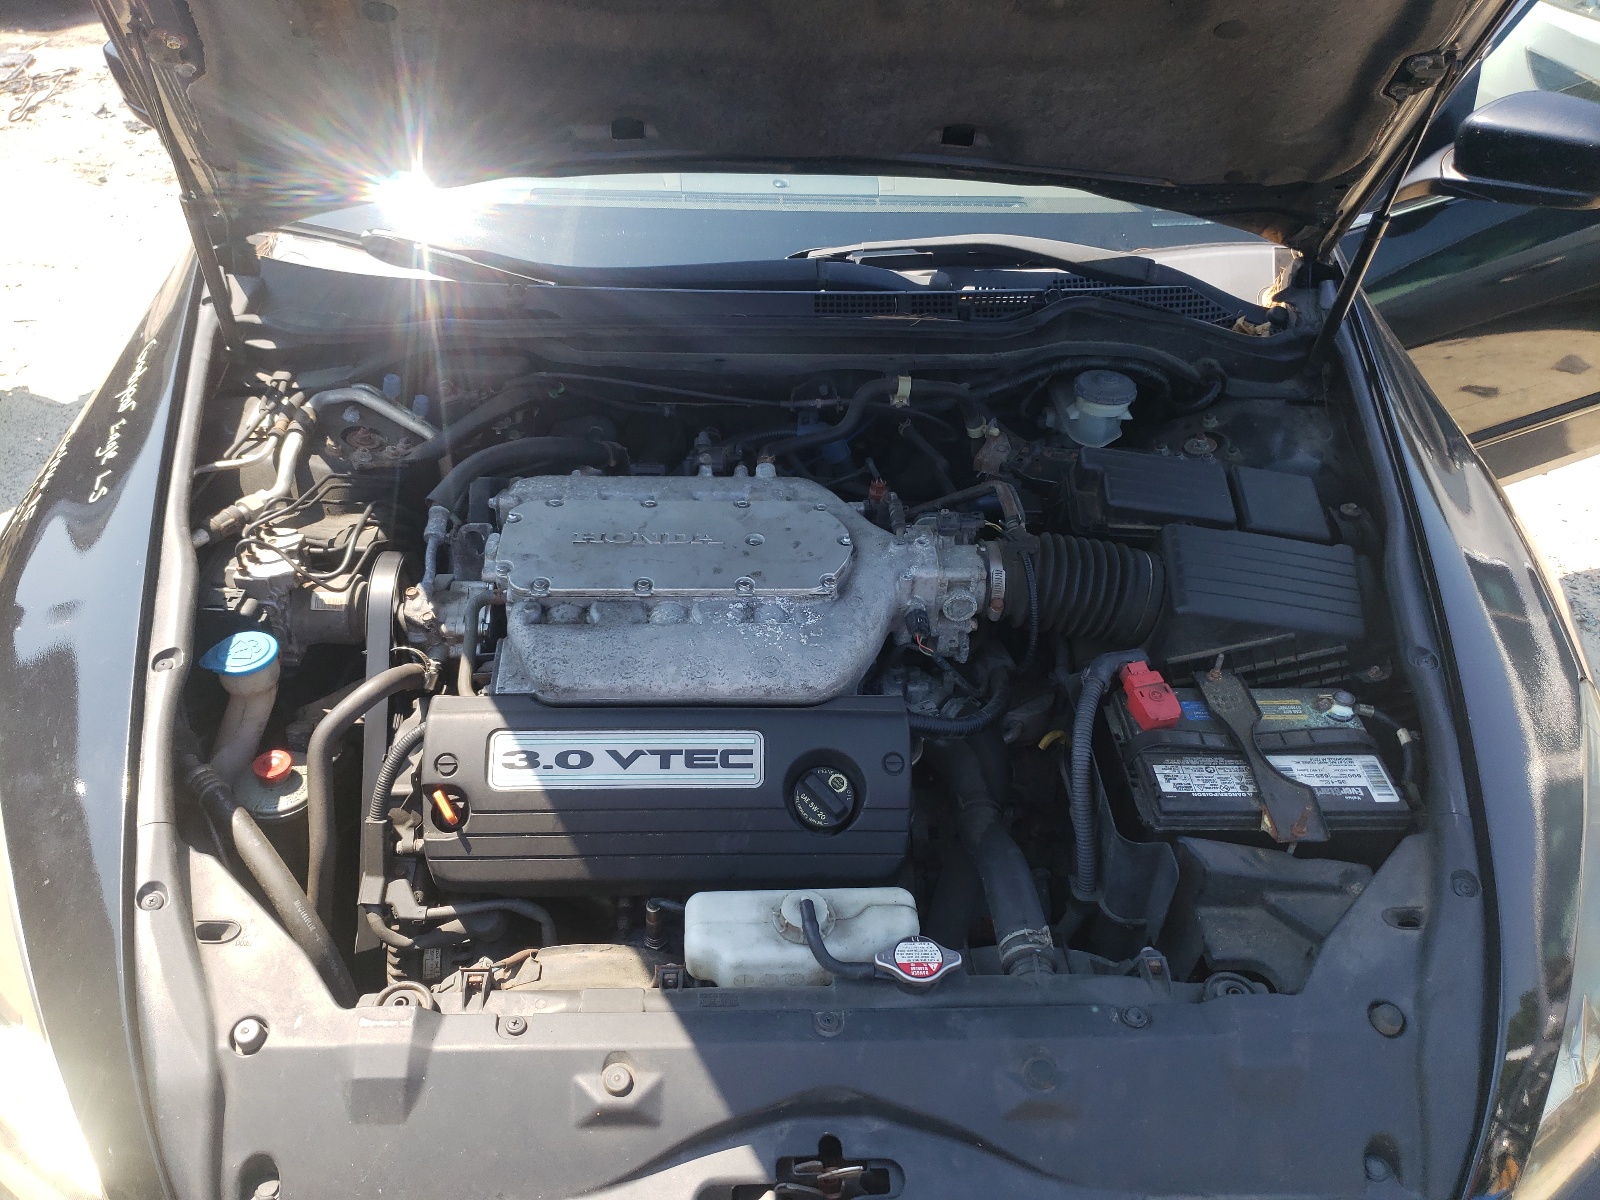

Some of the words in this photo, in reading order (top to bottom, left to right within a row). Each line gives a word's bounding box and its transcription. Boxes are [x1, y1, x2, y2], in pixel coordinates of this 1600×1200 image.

[572, 532, 724, 544] HONDA
[501, 749, 594, 770] 3.0
[605, 749, 754, 770] VTEC
[808, 802, 826, 820] 5W-20
